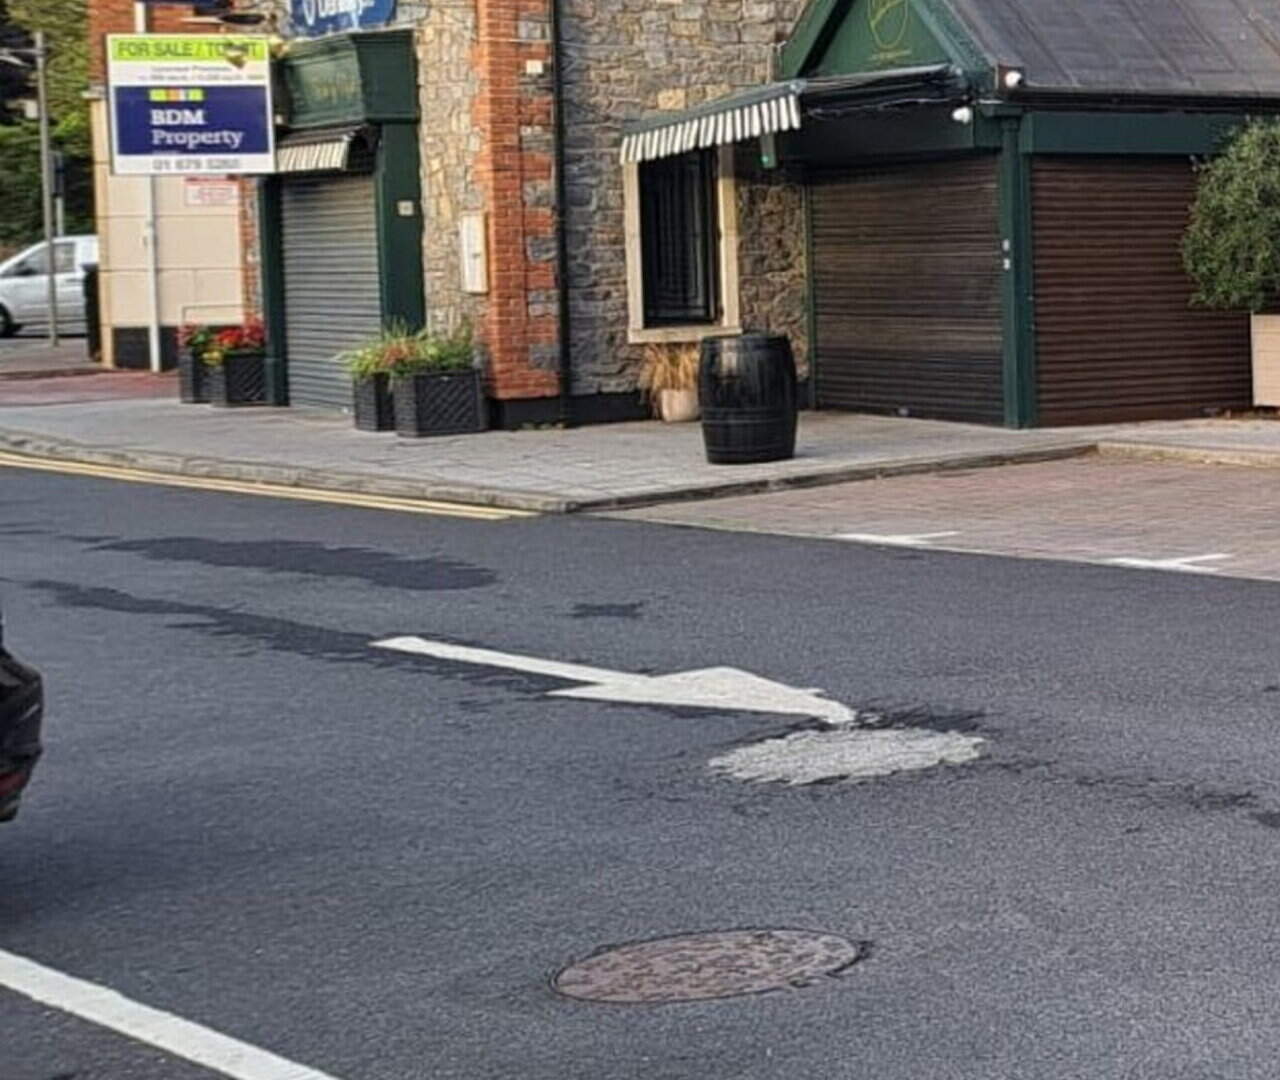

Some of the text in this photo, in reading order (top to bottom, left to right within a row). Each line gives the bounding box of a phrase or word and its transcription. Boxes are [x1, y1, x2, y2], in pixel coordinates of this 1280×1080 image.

[118, 41, 150, 57] FOR
[155, 41, 193, 57] SALE
[151, 109, 206, 125] BDM
[151, 129, 244, 150] Property
